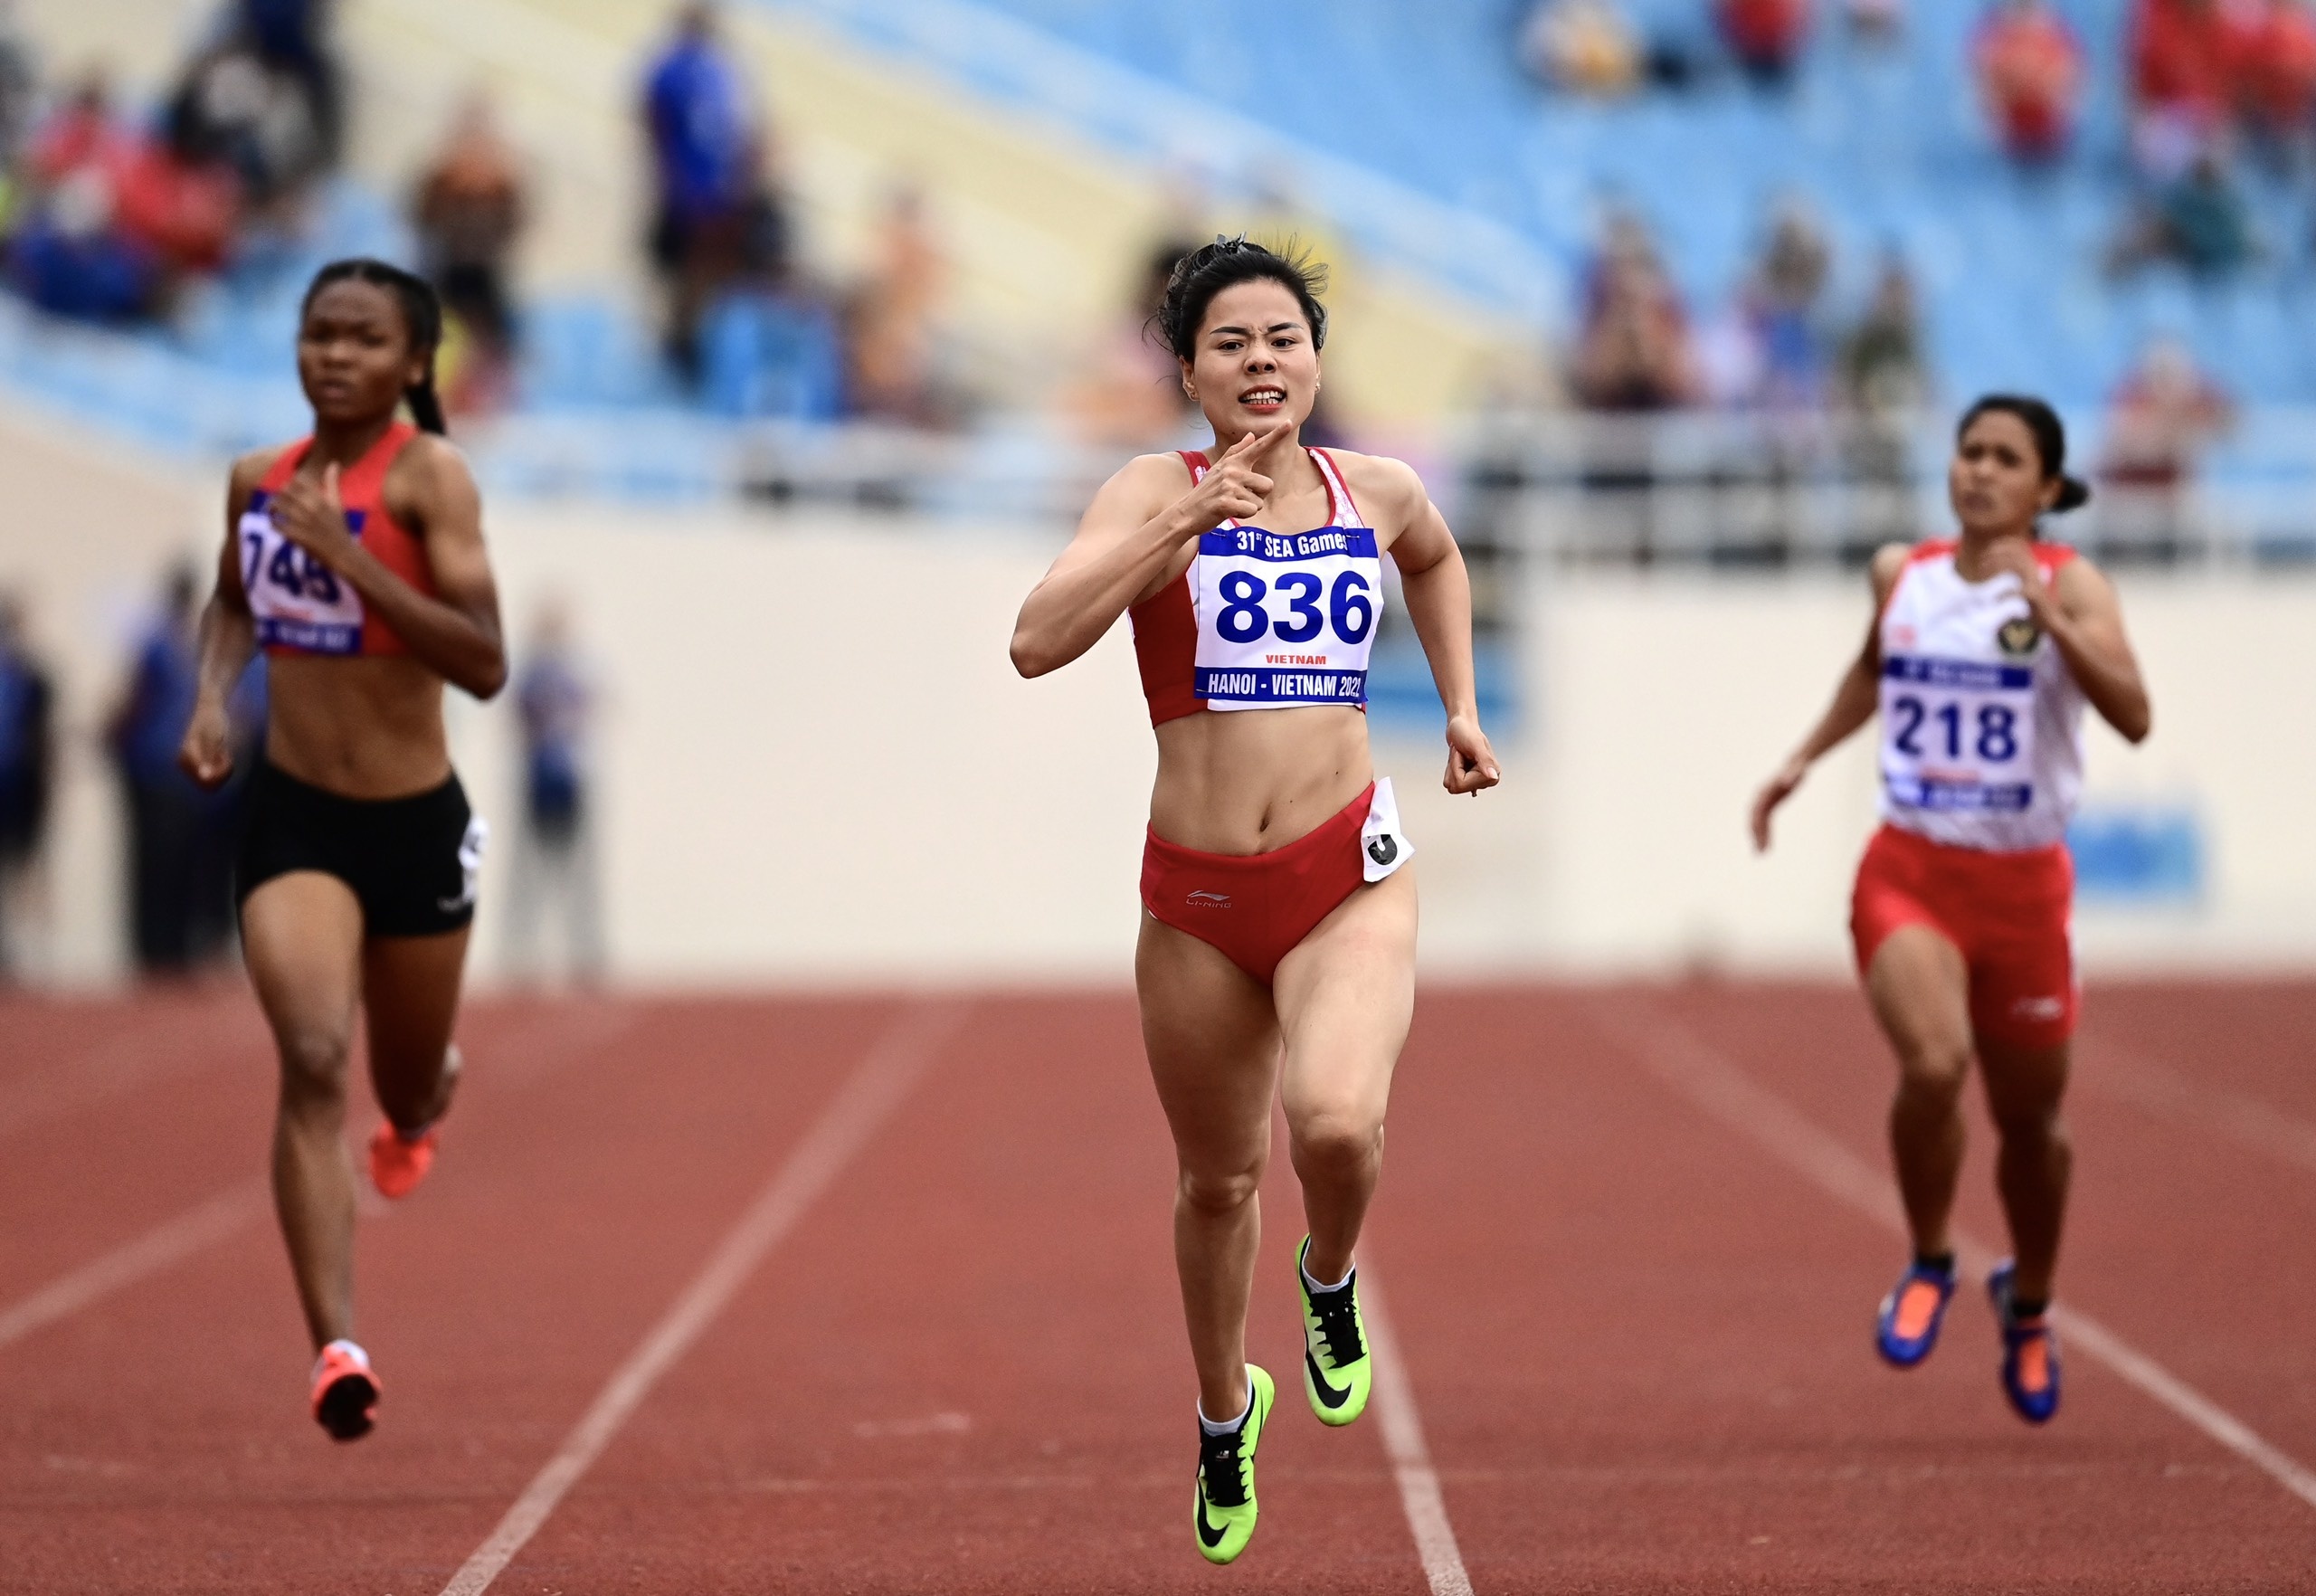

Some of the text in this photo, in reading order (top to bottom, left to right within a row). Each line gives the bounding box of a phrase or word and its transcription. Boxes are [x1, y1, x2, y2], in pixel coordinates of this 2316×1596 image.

[1265, 536, 1295, 558] SEA
[1296, 532, 1348, 556] Games
[1216, 570, 1372, 645] 836
[1266, 654, 1327, 665] VIETNAM
[1208, 673, 1257, 695] HANOI
[1272, 674, 1337, 697] VIETNAM
[1894, 696, 2017, 762] 218
[1185, 898, 1232, 908] LI-NING
